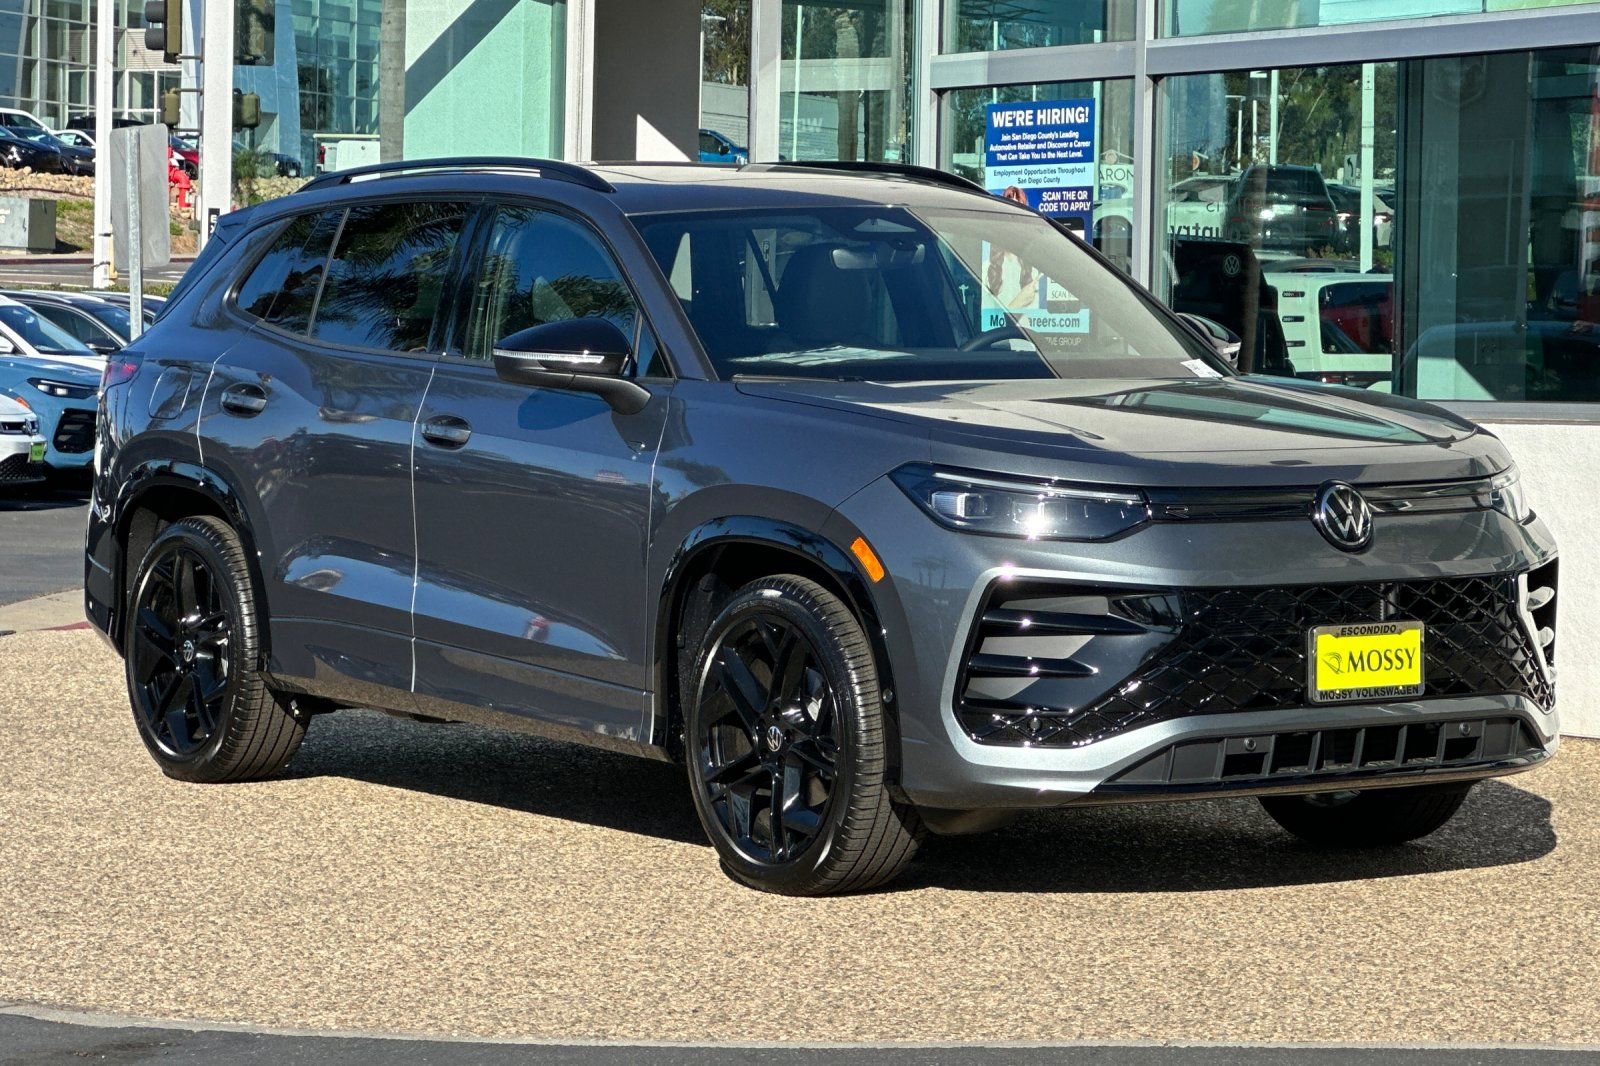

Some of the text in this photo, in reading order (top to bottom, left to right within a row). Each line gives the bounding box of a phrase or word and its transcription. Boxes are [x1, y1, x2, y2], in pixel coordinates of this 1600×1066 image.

[992, 106, 1089, 128] WE'RE HIRING!
[1001, 133, 1011, 141] Join
[1022, 132, 1036, 141] Diego
[1038, 132, 1058, 140] County's
[1060, 130, 1079, 140] Leading
[990, 143, 1016, 151] Automotive
[1018, 142, 1036, 150] Retailer
[1047, 141, 1069, 149] Discover
[1074, 140, 1090, 148] Career
[1008, 152, 1018, 160] Can
[1018, 152, 1030, 160] Take
[1031, 151, 1040, 159] You
[1056, 150, 1068, 158] Next
[1068, 150, 1083, 158] Level.
[994, 166, 1086, 178] Employment Opportunities Throughout
[1028, 176, 1042, 185] Diego
[1044, 176, 1060, 184] County
[1042, 190, 1088, 201] SCAN THE QR
[1038, 202, 1091, 212] CODE TO APPLY
[1341, 624, 1396, 636] ESCONDIDO
[1347, 647, 1416, 672] MOSSY
[1320, 685, 1419, 700] MOSSY VOLKSWAGEN
